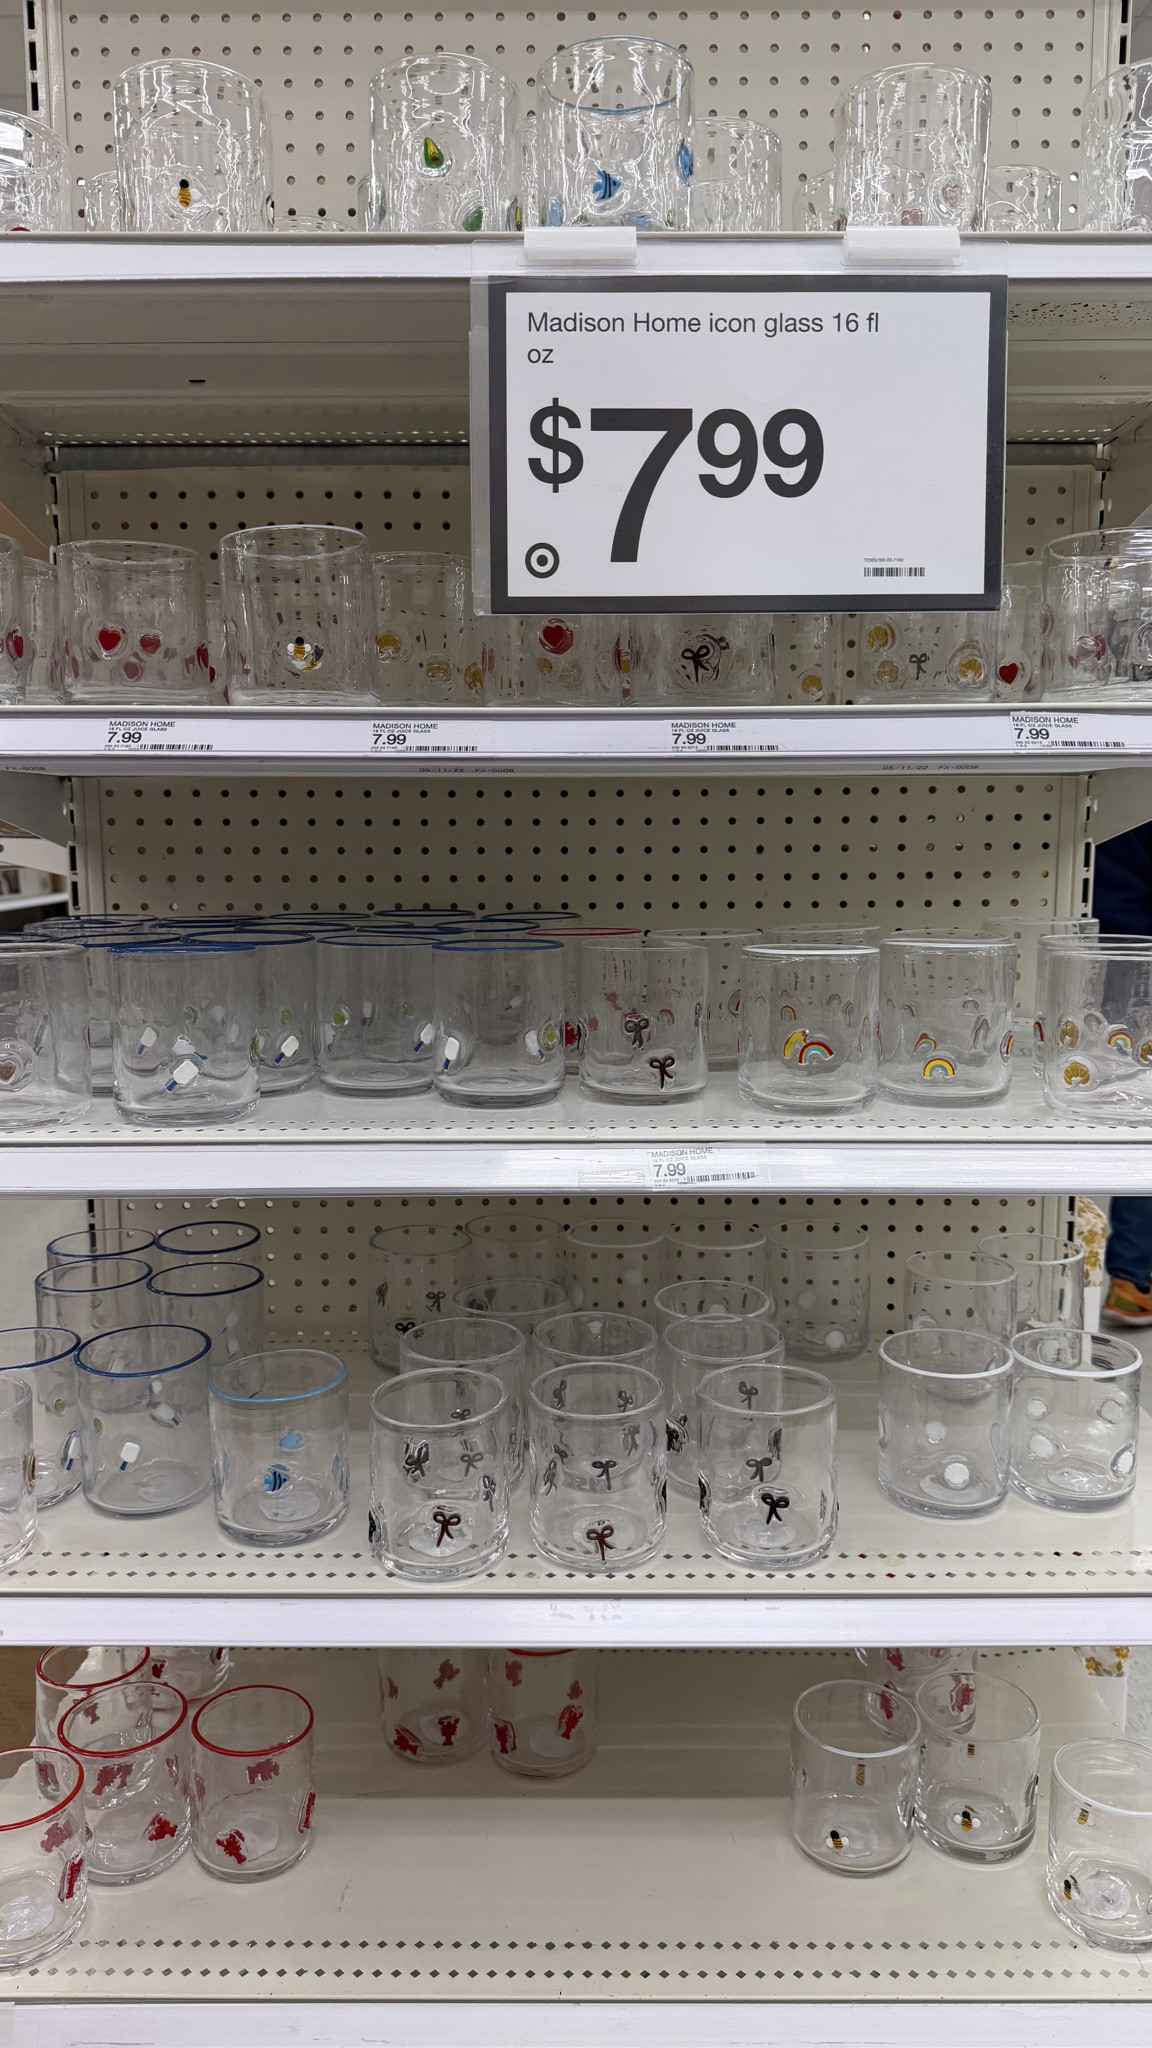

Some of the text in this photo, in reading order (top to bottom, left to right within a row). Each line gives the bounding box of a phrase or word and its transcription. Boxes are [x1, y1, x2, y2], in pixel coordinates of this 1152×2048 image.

[528, 312, 879, 338] Madison Home icon glass 16 fl
[527, 348, 554, 364] oz
[107, 732, 142, 743] 7.99
[672, 733, 707, 744] 7.99
[1014, 728, 1050, 739] 7.99
[372, 734, 407, 745] 7.99
[651, 1147, 714, 1158] MADISON HOME
[653, 1163, 686, 1178] 7.99
